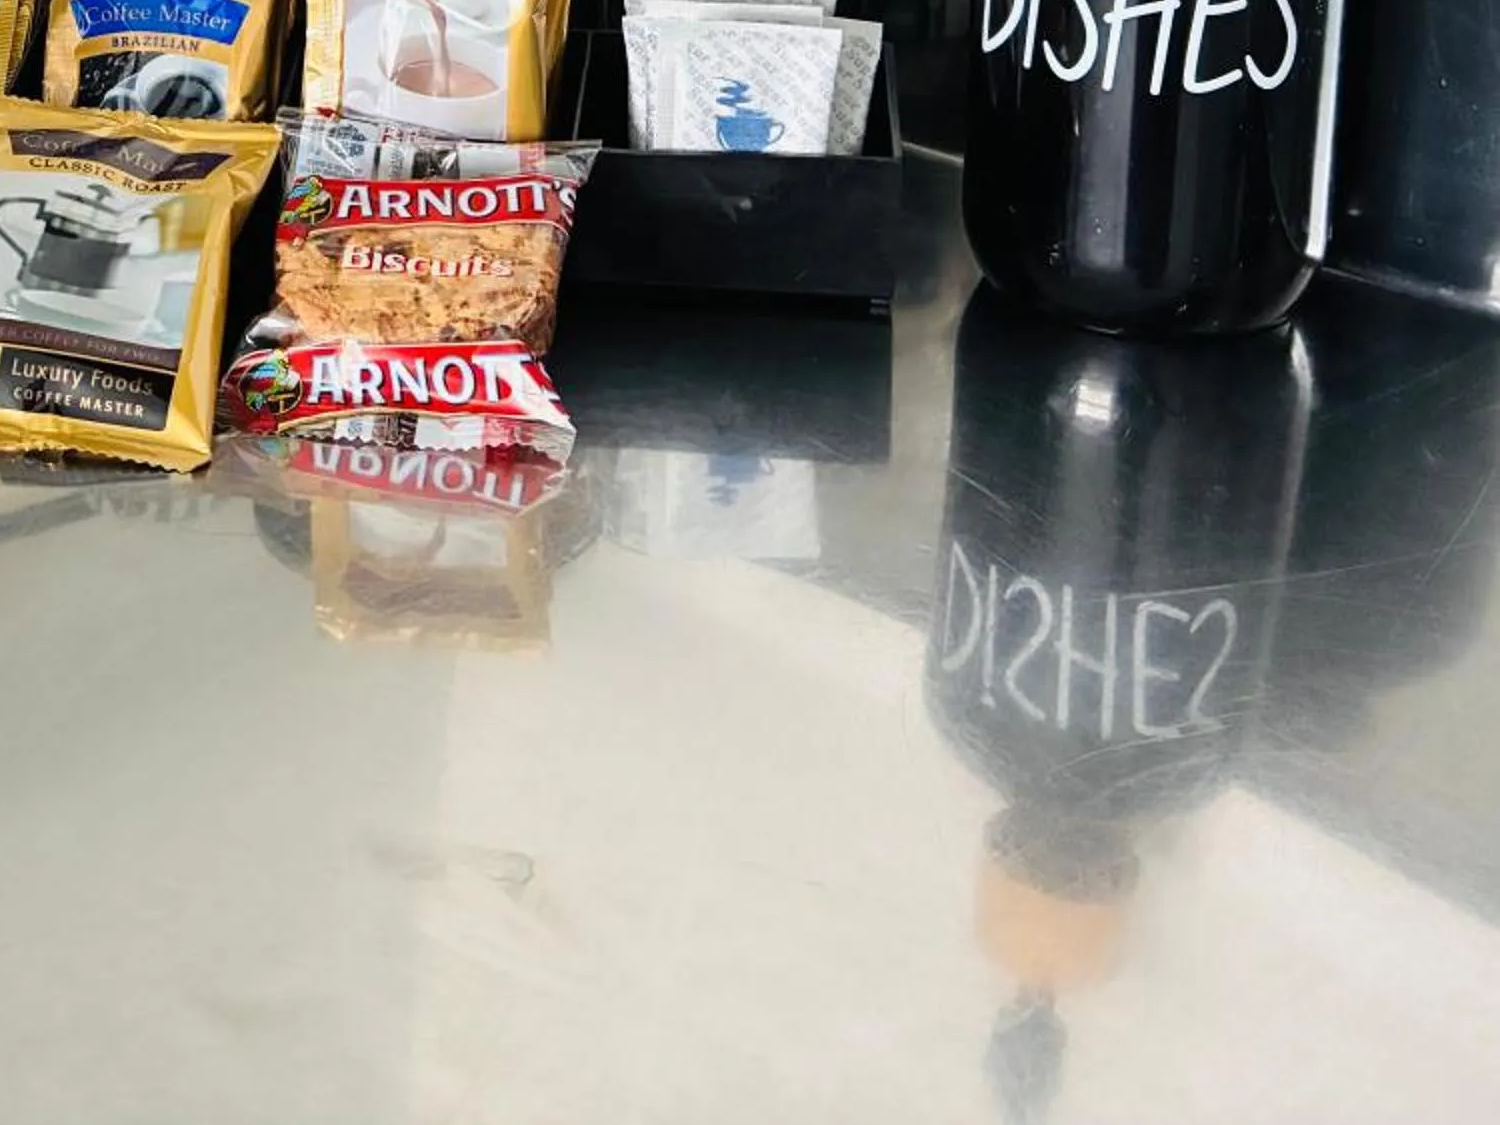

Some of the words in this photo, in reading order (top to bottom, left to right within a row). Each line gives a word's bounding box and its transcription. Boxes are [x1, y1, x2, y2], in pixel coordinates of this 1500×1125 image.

[80, 2, 151, 26] Coffee
[158, 4, 232, 32] Master
[111, 35, 200, 53] BRAZILIAN
[28, 157, 115, 184] CLASSIC
[122, 177, 188, 193] ROAST
[341, 243, 513, 277] Biscuits
[11, 358, 84, 392] Luxury
[90, 370, 153, 396] Foods
[13, 385, 72, 406] COFFEE
[79, 395, 146, 418] MASTER
